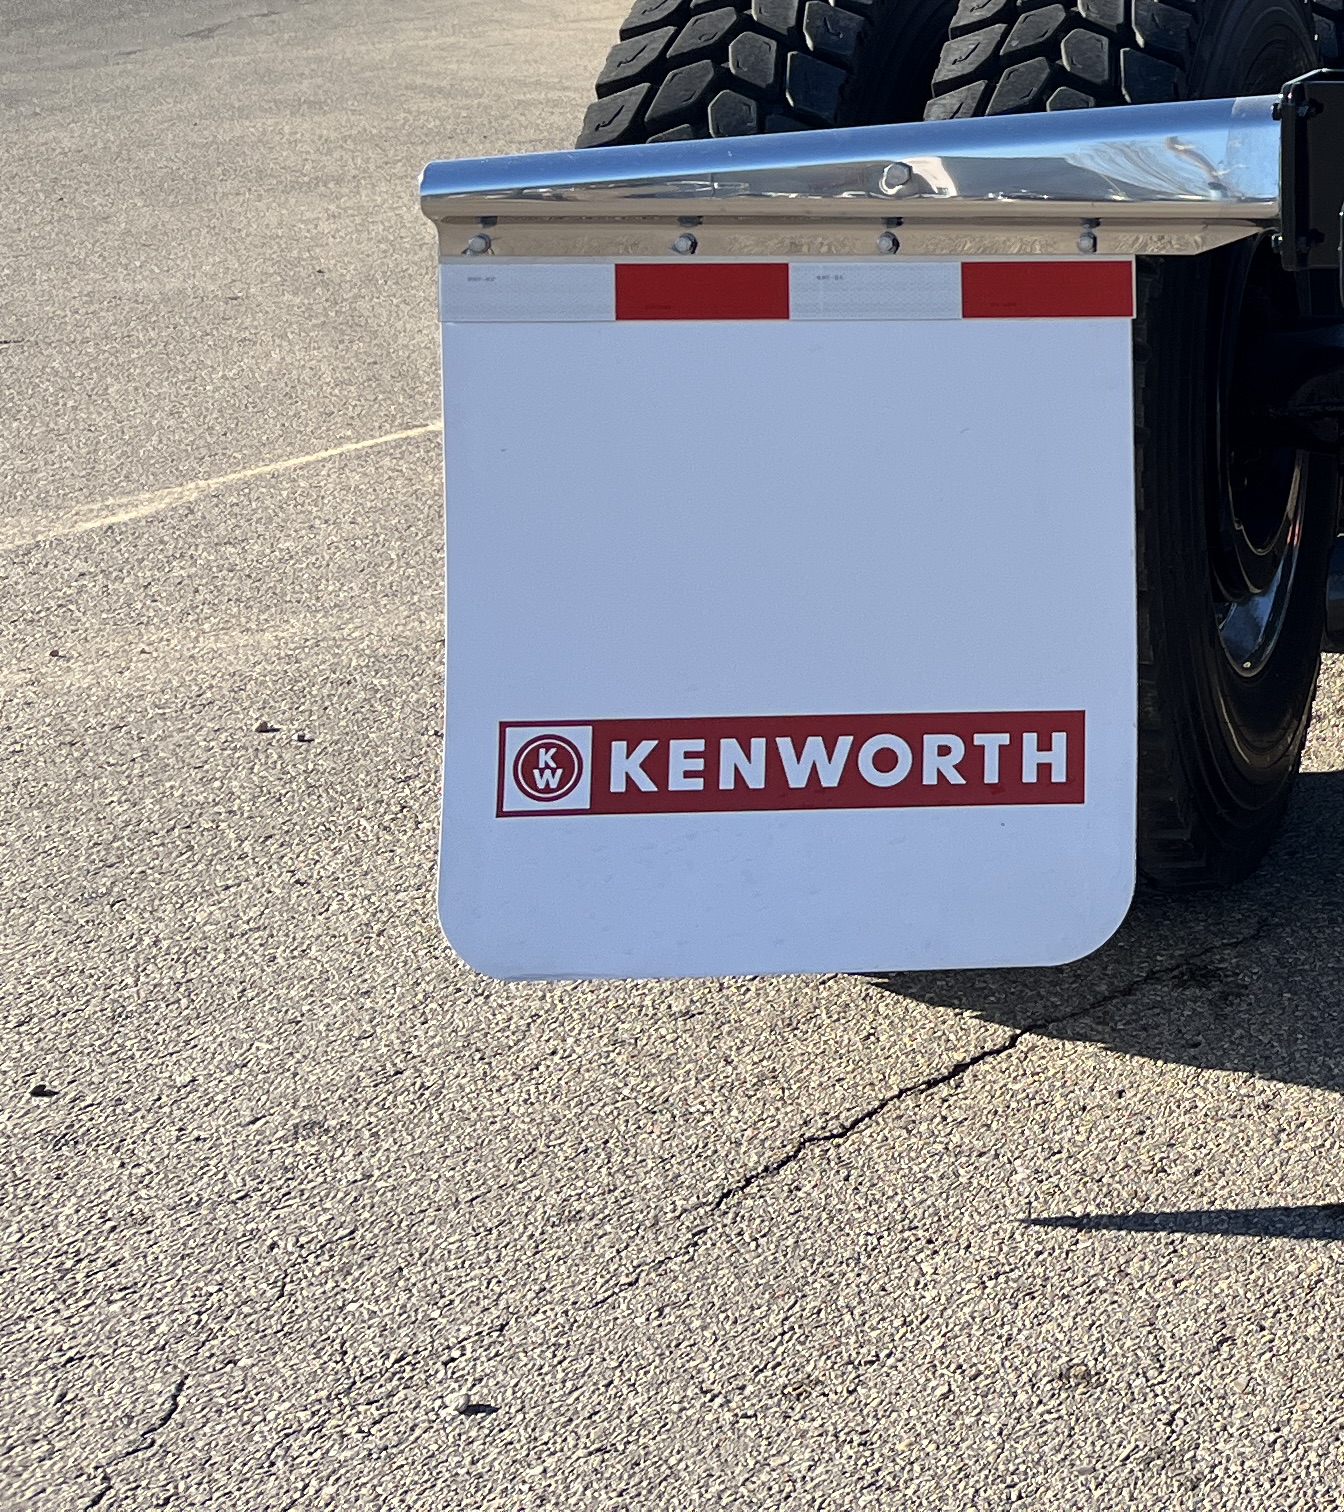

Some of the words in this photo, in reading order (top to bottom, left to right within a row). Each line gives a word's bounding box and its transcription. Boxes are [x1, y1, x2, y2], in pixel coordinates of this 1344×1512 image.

[538, 748, 557, 768] K
[609, 731, 1068, 793] KENWORTH
[532, 769, 563, 789] W
